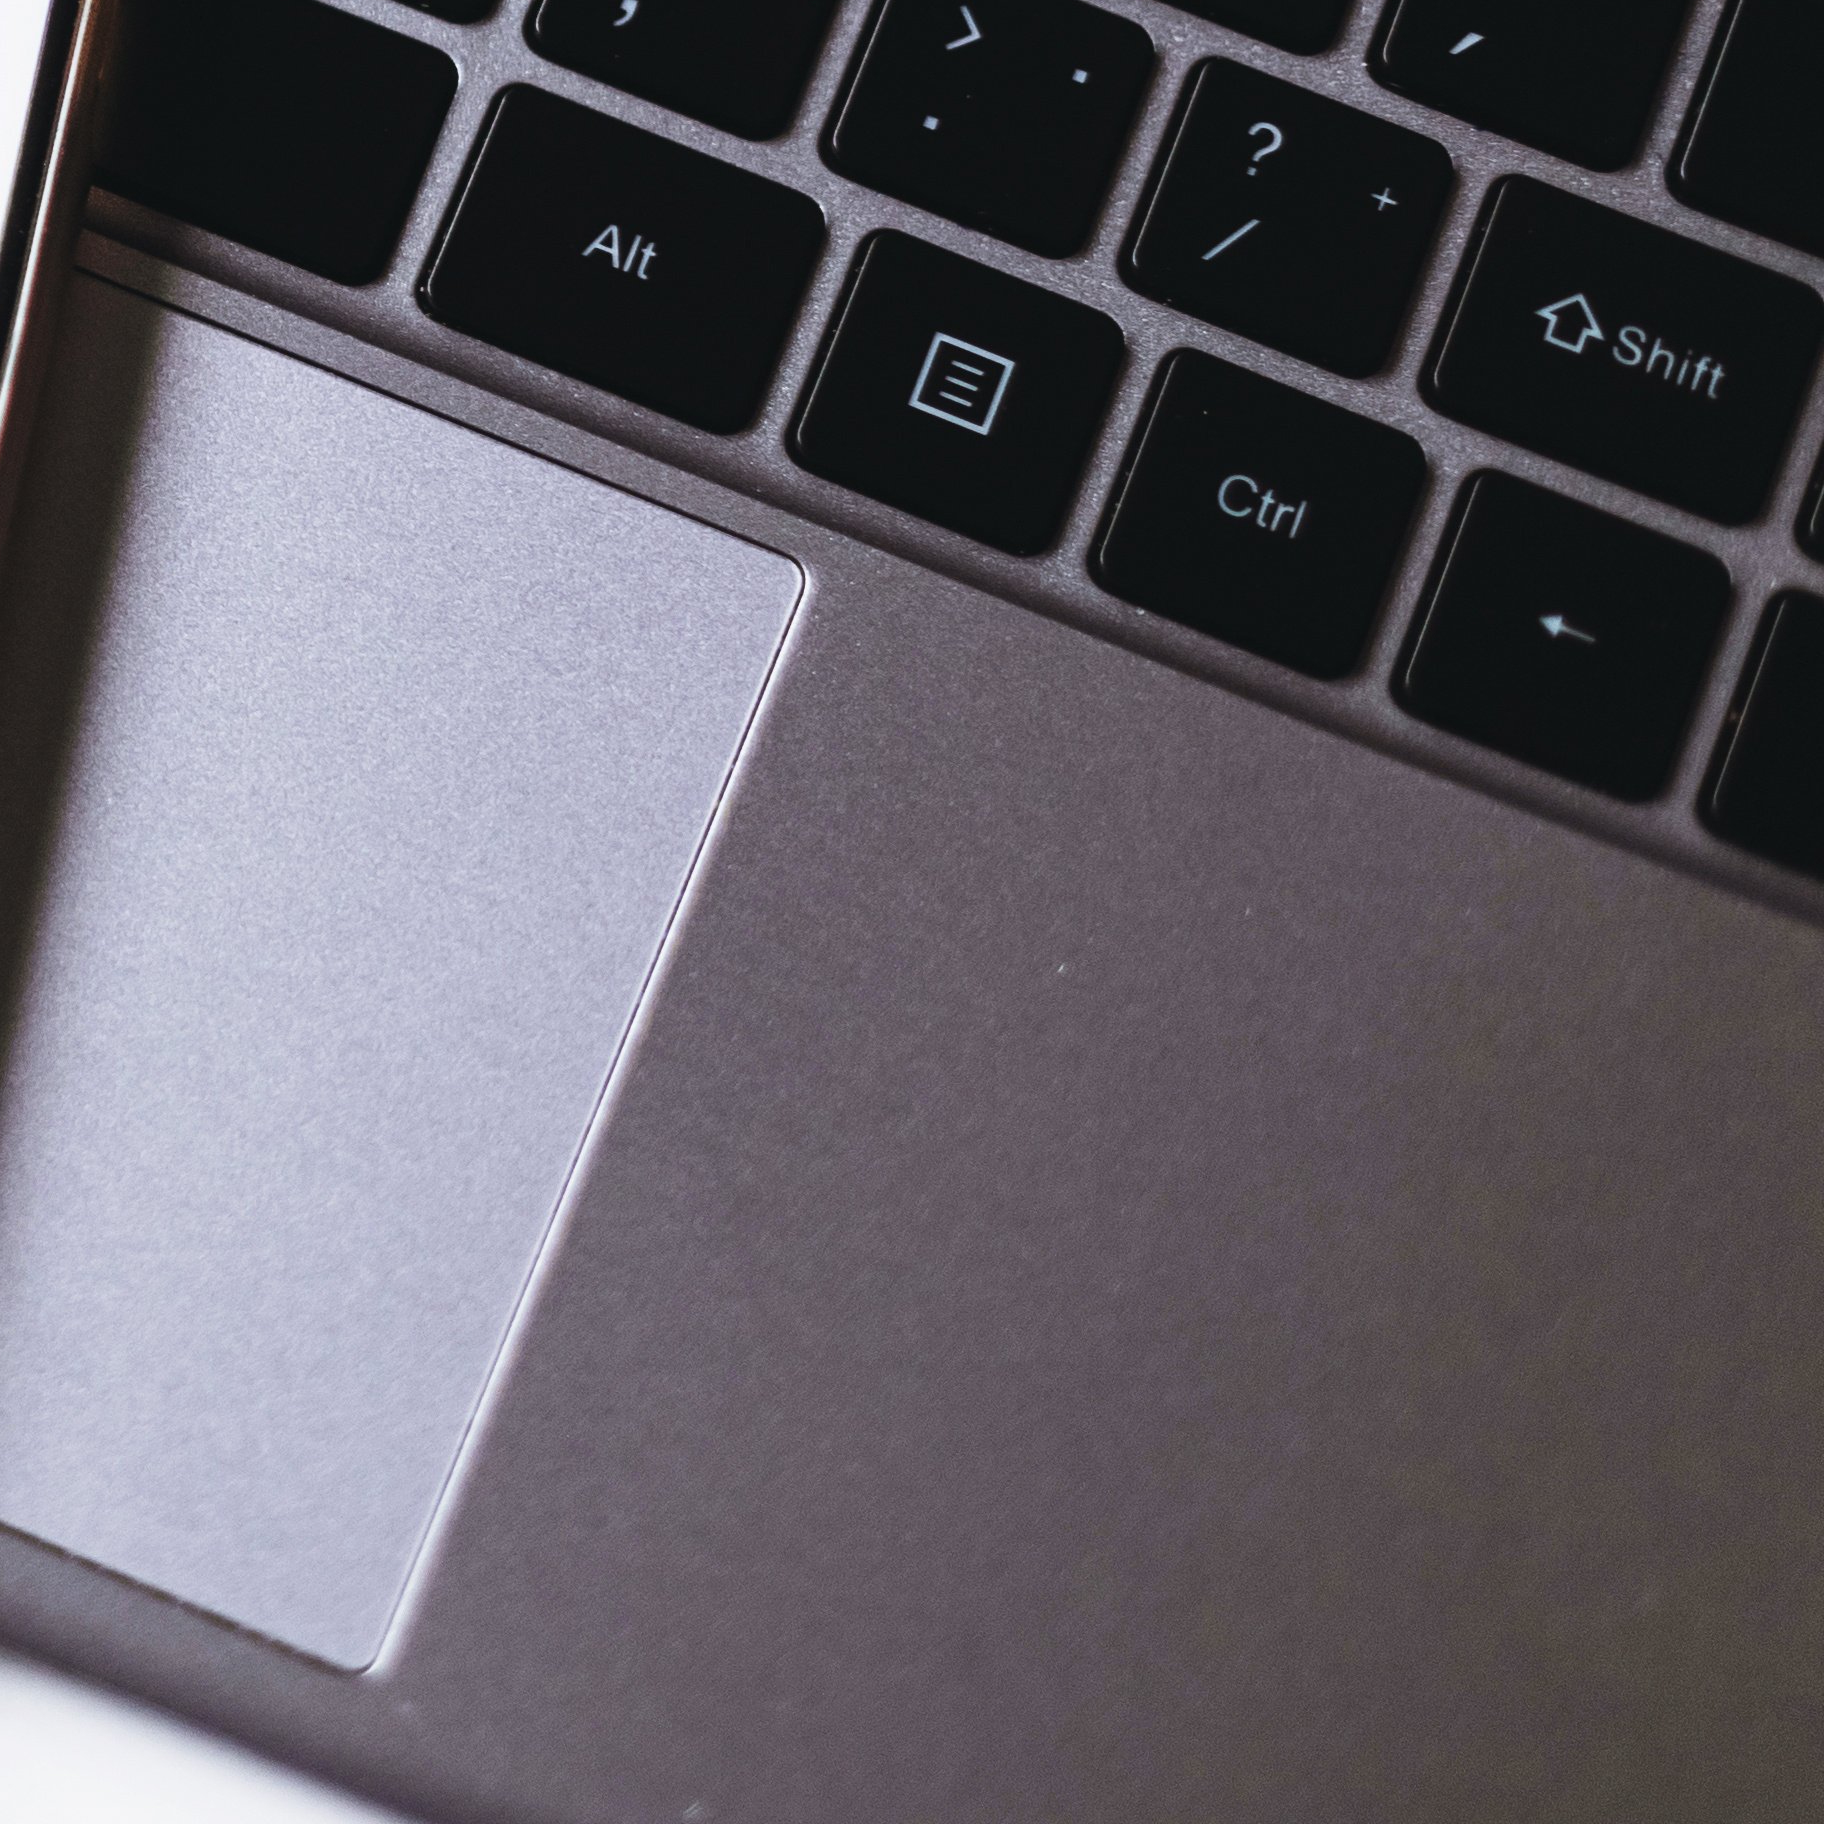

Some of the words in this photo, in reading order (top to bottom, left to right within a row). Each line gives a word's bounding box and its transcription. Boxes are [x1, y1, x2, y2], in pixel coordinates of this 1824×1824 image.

[945, 5, 983, 51] >
[1247, 121, 1284, 177] ?
[1371, 187, 1398, 212] +
[581, 224, 658, 281] Alt
[1201, 218, 1261, 261] /
[1612, 325, 1726, 400] Shift
[1217, 473, 1308, 539] Ctrl
